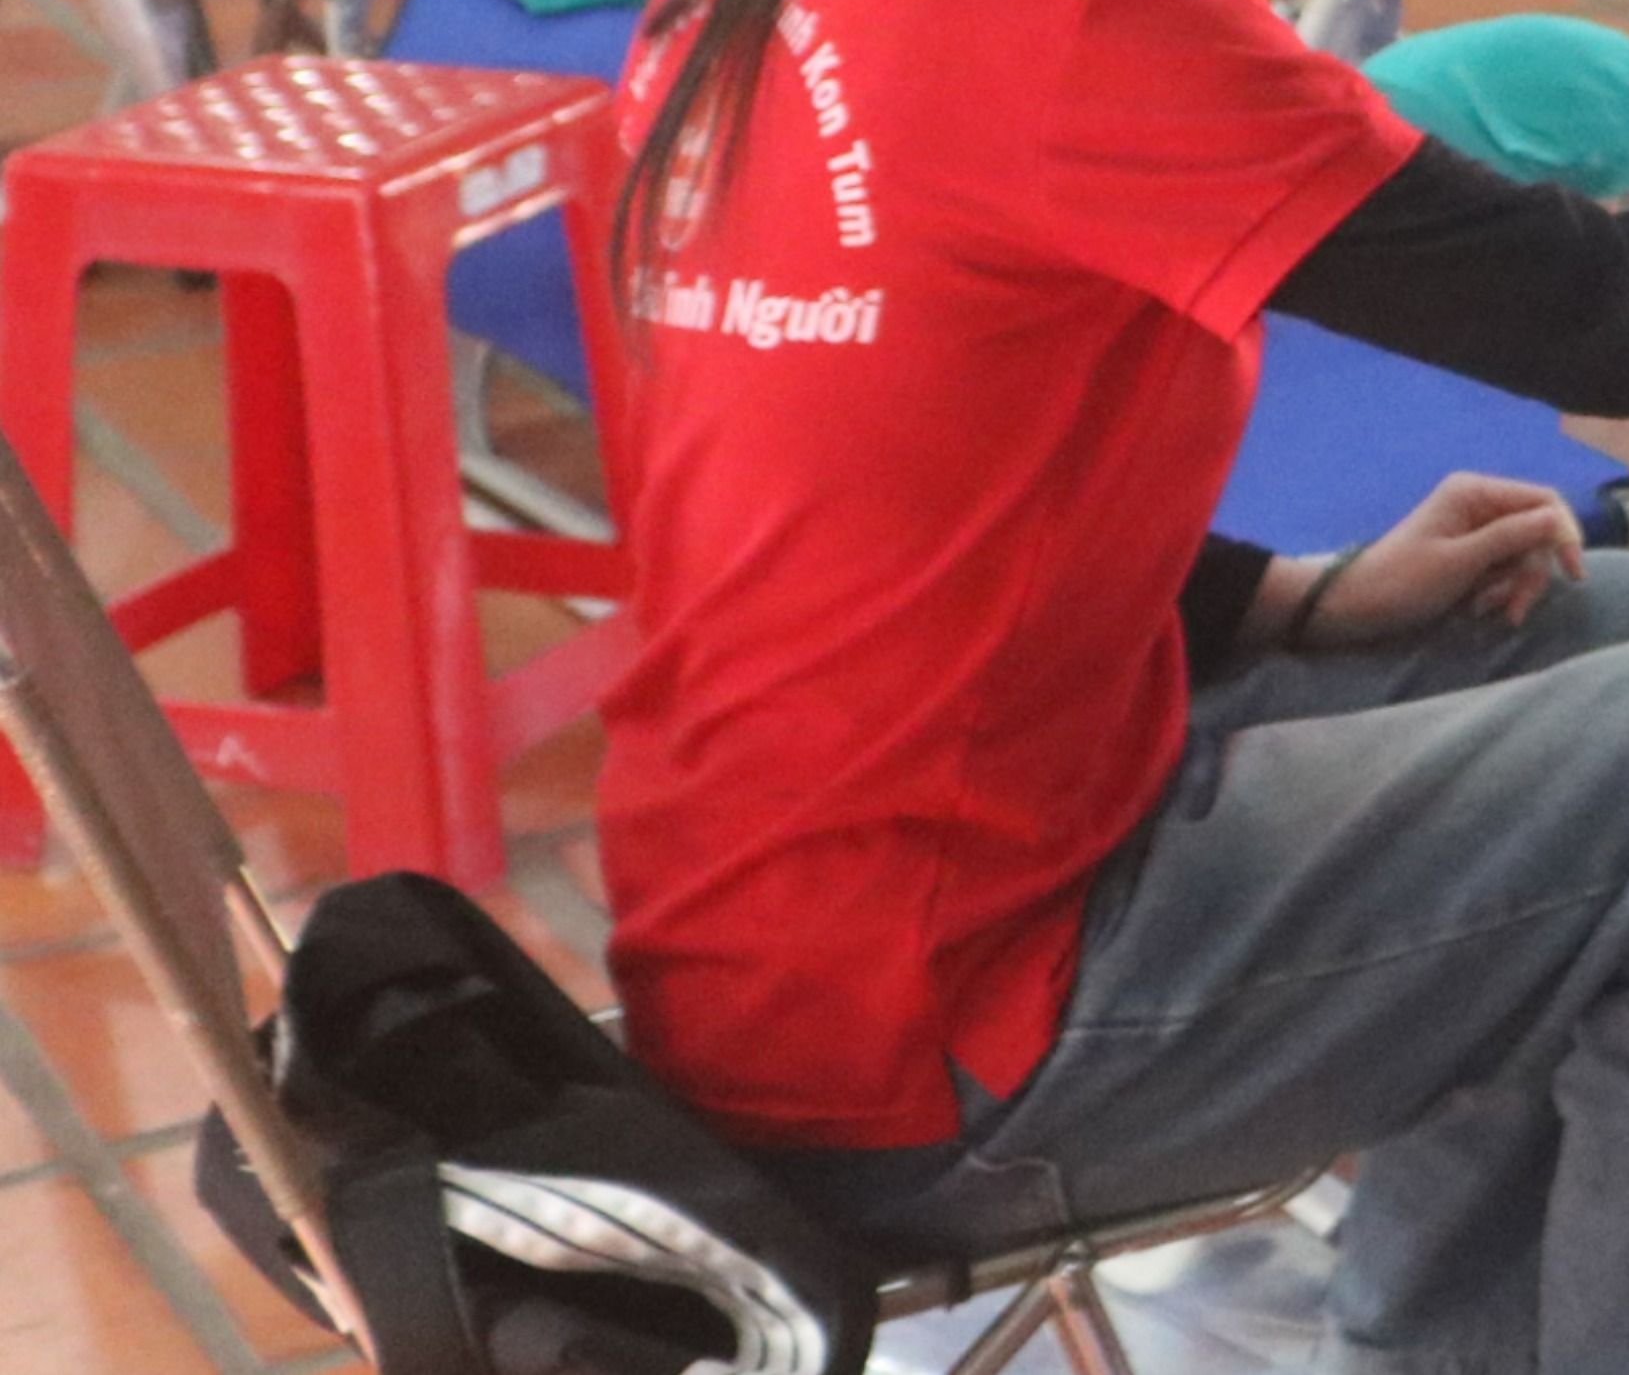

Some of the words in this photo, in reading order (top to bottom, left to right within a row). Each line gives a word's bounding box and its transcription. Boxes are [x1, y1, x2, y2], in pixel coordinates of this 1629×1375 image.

[801, 40, 850, 139] Kon
[827, 139, 877, 247] Tum
[720, 277, 884, 349] Người
